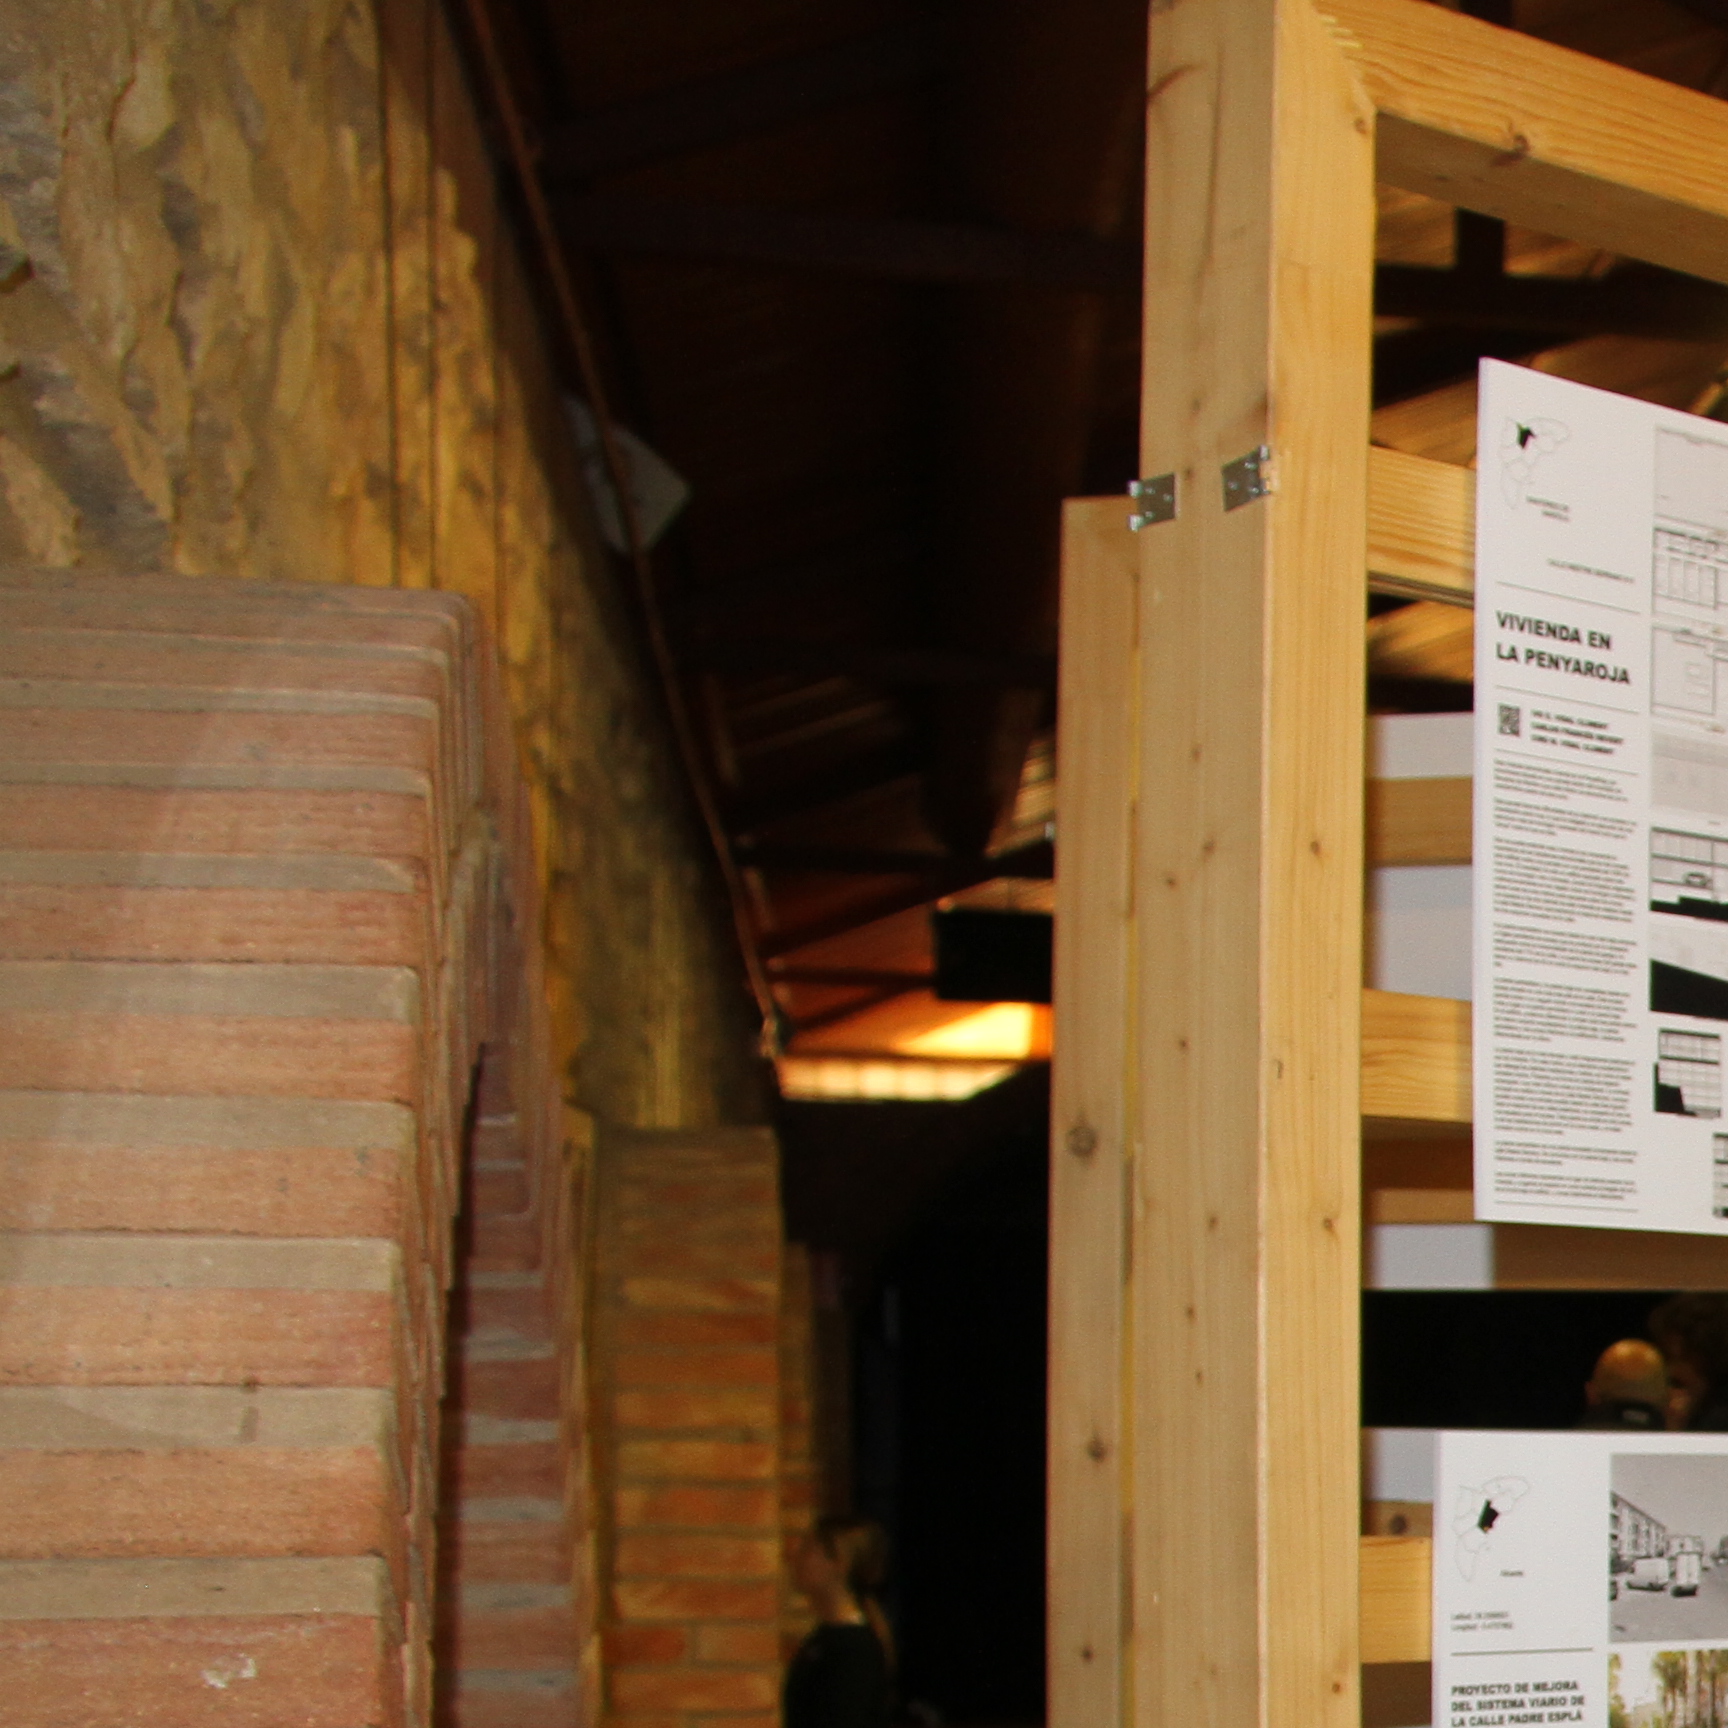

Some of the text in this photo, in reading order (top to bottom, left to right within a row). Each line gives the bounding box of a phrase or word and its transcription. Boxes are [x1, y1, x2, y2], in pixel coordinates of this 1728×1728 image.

[1496, 610, 1611, 650] VIVIENDA EN
[1496, 642, 1630, 684] LA PENYAROJA
[1451, 1681, 1578, 1695] PROYECTO DE MEJORA
[1451, 1695, 1585, 1712] DEL SISTEMA VIARIO DE
[1451, 1718, 1465, 1728] LA
[1469, 1715, 1504, 1726] CALLE
[1508, 1713, 1543, 1723] PADRE
